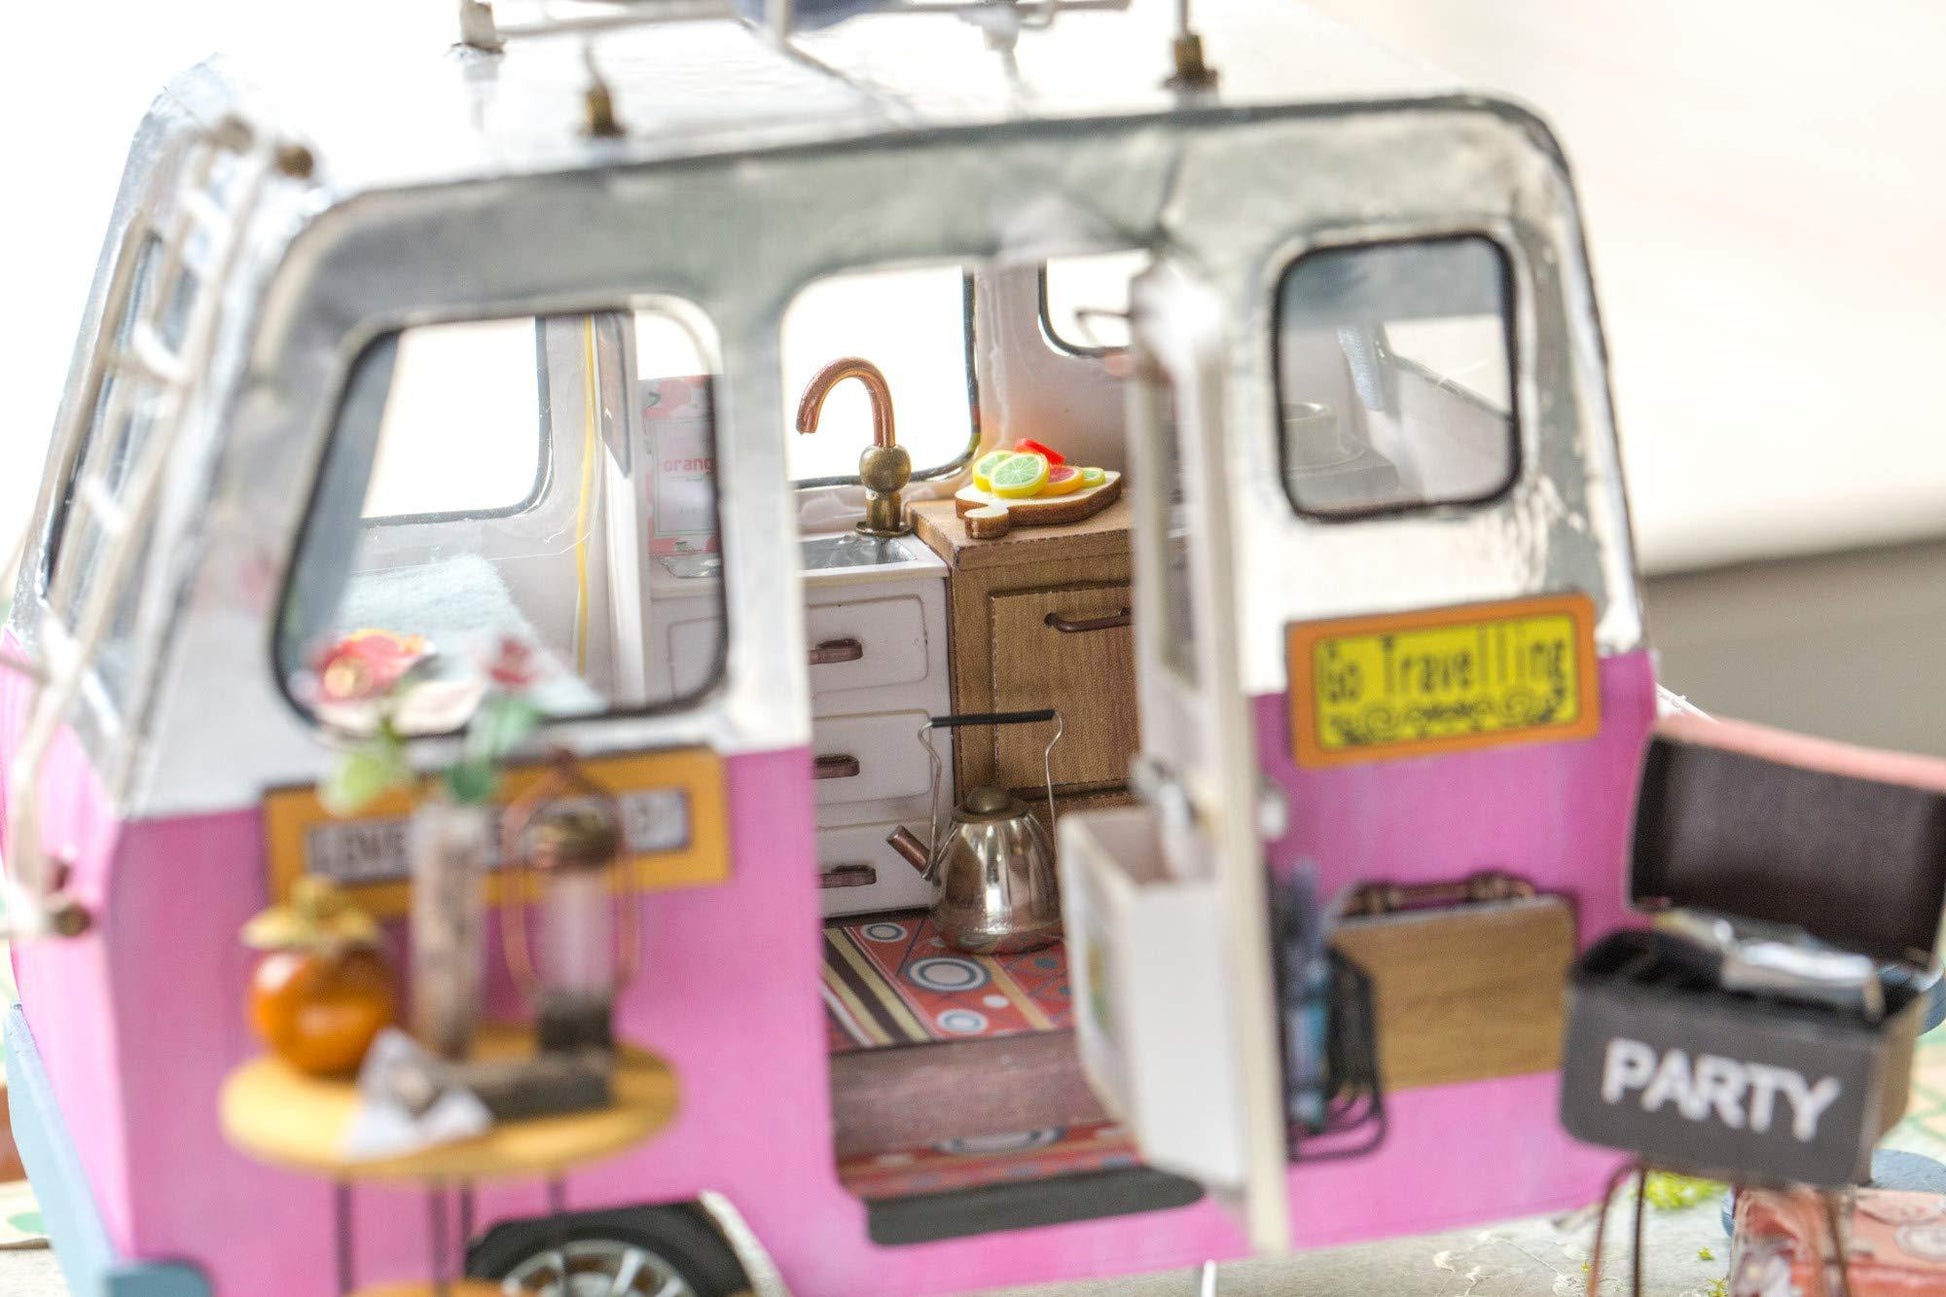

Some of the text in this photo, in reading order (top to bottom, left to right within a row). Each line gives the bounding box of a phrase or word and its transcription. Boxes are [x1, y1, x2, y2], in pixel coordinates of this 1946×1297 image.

[1317, 621, 1566, 704] Go Travelling
[1602, 1037, 1841, 1142] PARTY
